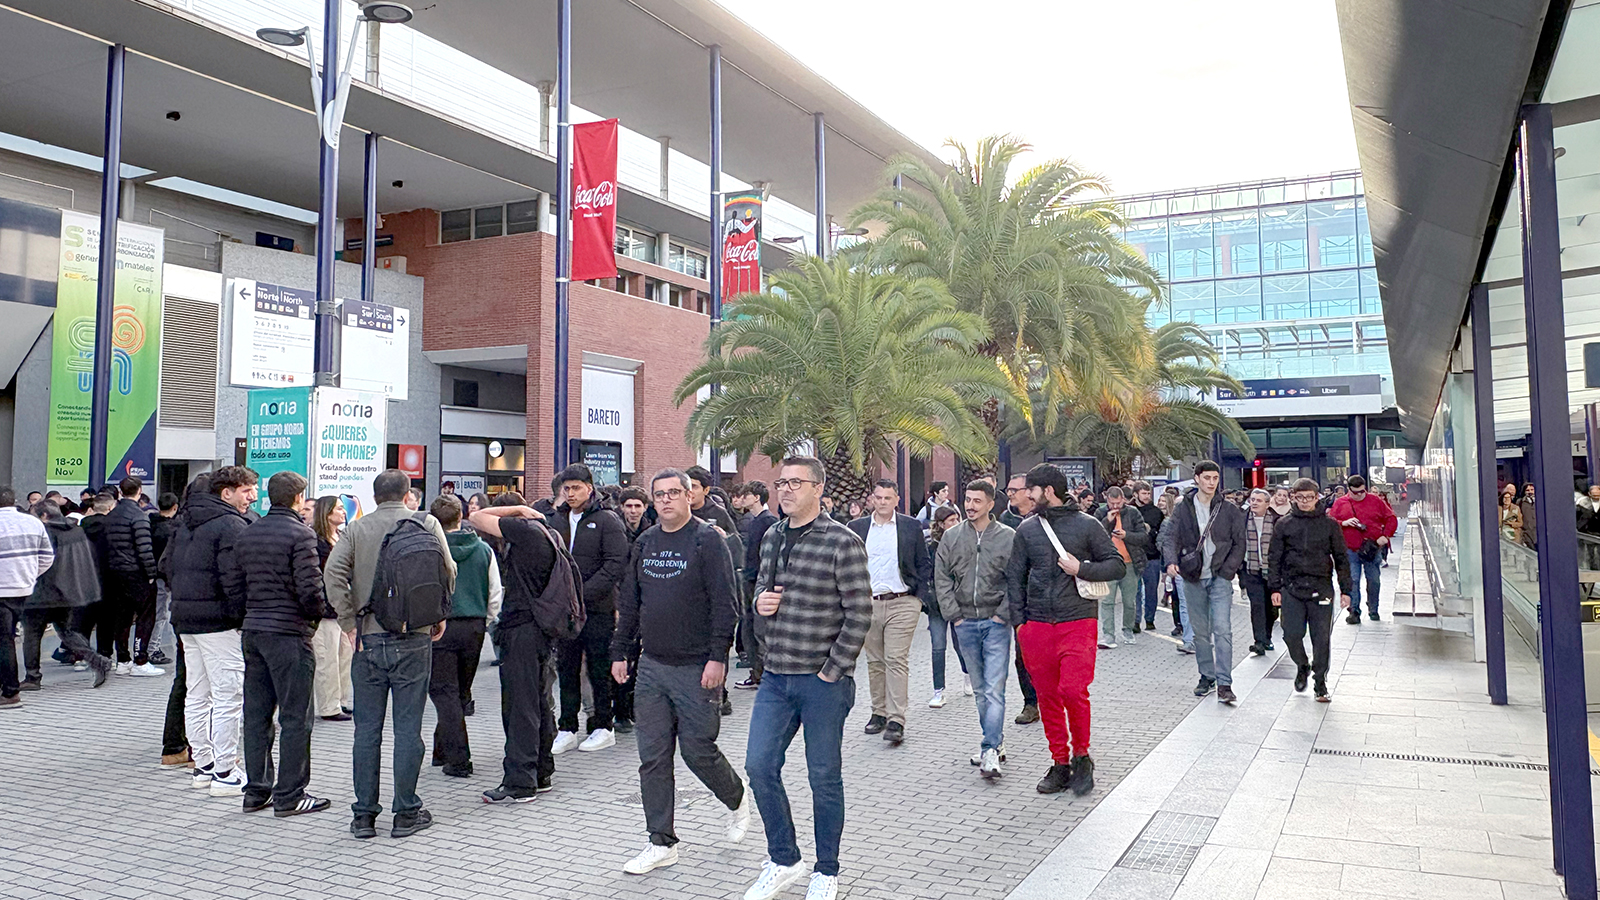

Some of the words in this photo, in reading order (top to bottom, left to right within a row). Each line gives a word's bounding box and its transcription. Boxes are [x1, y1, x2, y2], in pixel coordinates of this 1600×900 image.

[117, 241, 156, 253] TRIFICACIÓN
[75, 253, 99, 263] gener
[124, 261, 155, 273] matelec
[257, 290, 280, 302] Norte
[283, 294, 303, 305] North
[361, 309, 374, 318] Sur
[375, 311, 393, 321] South
[260, 401, 297, 416] noria
[332, 403, 373, 418] noria
[588, 408, 620, 426] BARETO
[261, 423, 283, 436] GRUPO
[284, 422, 305, 435] NORIA
[322, 424, 368, 442] ¿QUIERES
[251, 437, 259, 450] LO
[260, 437, 291, 450] TENEMOS
[250, 450, 266, 459] todo
[321, 442, 335, 459] UN
[337, 444, 378, 461] IPHONE?
[55, 458, 83, 466] 18-20
[320, 463, 352, 472] Visitando
[55, 468, 74, 476] Nov
[319, 473, 338, 481] stand
[463, 481, 482, 489] BARETO
